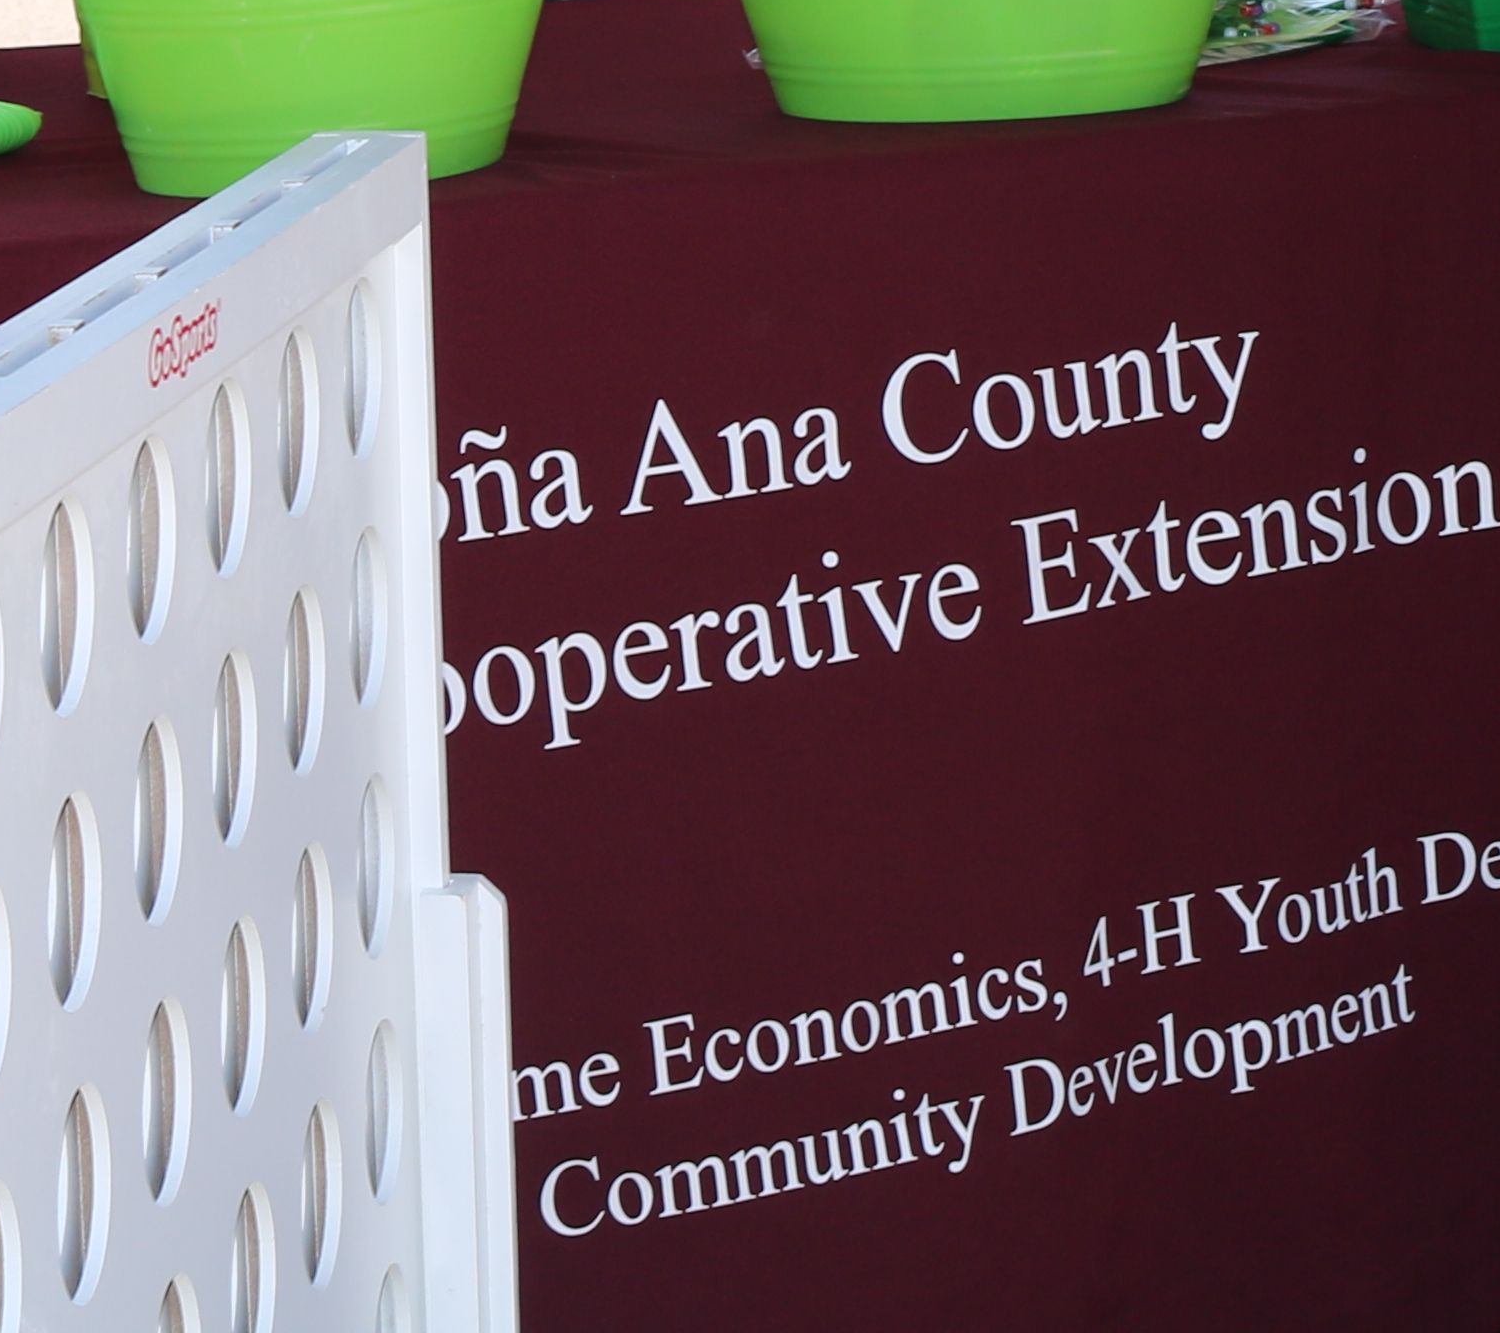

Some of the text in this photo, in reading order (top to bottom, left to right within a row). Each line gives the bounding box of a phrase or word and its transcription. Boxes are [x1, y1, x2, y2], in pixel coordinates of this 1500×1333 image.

[147, 301, 218, 389] GoSports
[438, 321, 1260, 543] ña Ana County
[442, 551, 982, 750] operative
[512, 1054, 621, 1124] me
[642, 949, 1068, 1096] Economics,
[1083, 893, 1201, 987] 4-H
[1215, 847, 1403, 954] Youth
[540, 964, 1415, 1236] Community Development
